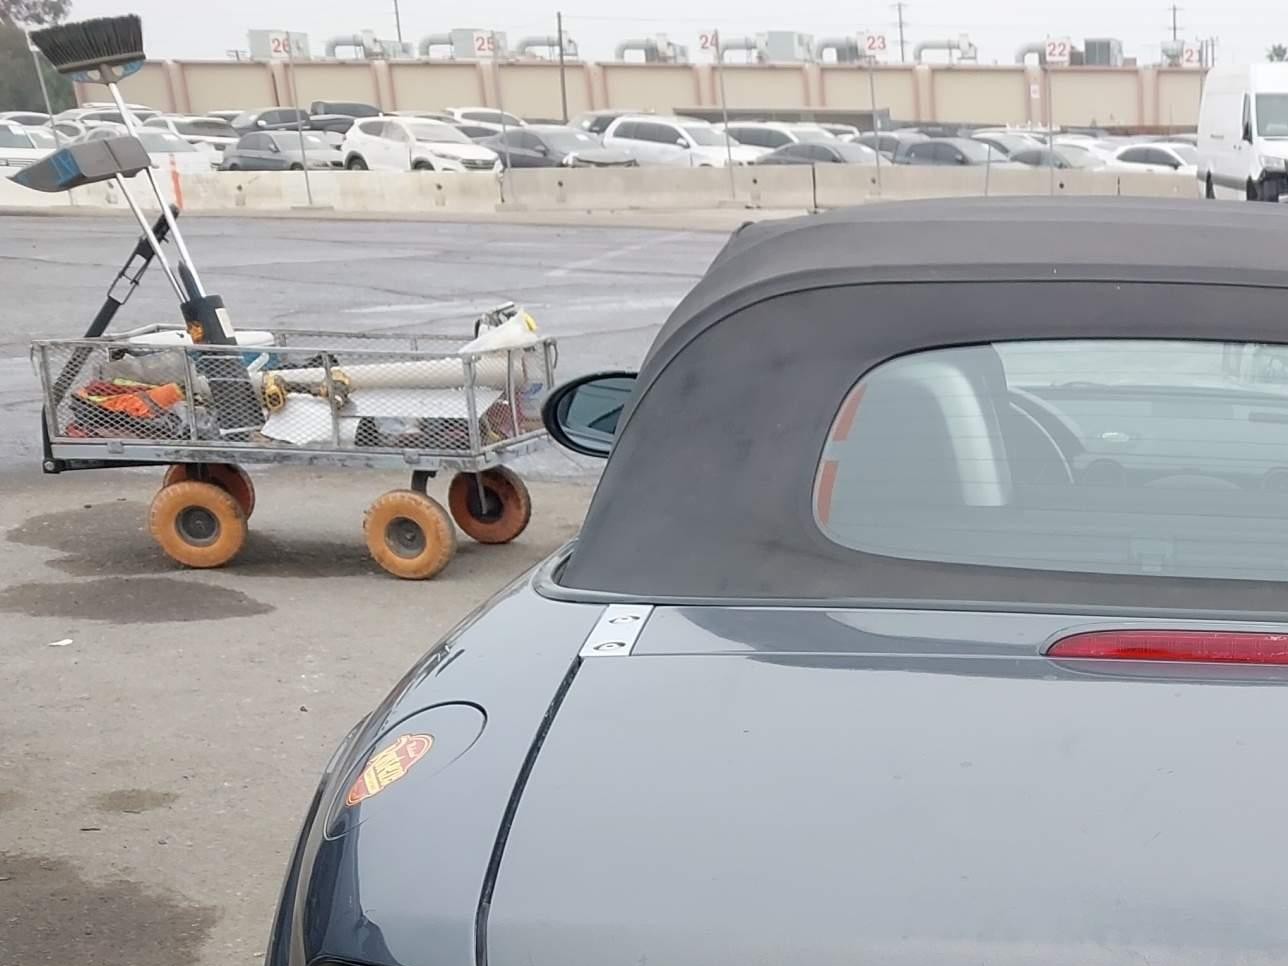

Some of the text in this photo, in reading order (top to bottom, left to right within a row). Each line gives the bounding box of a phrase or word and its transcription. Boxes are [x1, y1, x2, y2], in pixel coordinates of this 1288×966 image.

[476, 36, 497, 51] 25
[700, 34, 719, 49] 24
[867, 35, 886, 50] 23
[1048, 42, 1066, 57] 22
